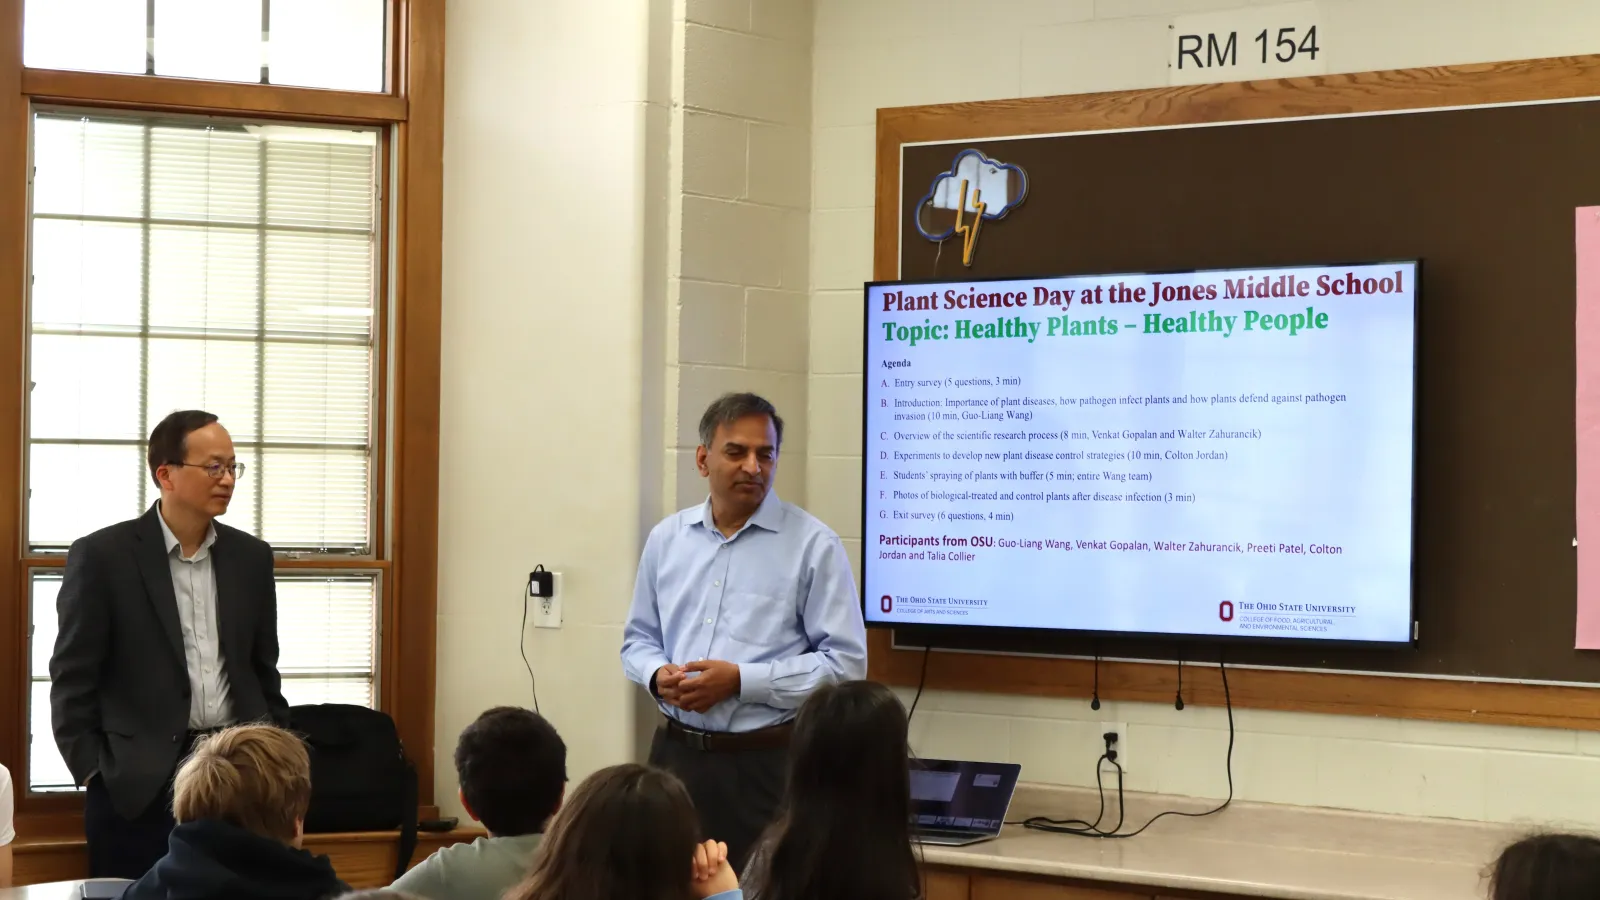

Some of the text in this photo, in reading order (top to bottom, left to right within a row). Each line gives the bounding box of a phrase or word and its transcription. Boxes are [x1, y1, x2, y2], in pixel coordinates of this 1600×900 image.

[1178, 25, 1319, 69] RM 154
[882, 270, 1403, 312] Plant Science Day at the Jones Middle School
[882, 319, 948, 346] Topic:
[955, 317, 1041, 343] Healthy
[1047, 314, 1118, 337] Plants
[1143, 310, 1237, 337] Healthy
[1244, 307, 1328, 336] People
[881, 359, 911, 369] Agenda
[881, 376, 1021, 389] A. Entry survey (5 questions, 3 min)
[880, 393, 1346, 408] B. Introduction: Importance of plant diseases, how pathogen infect plants and how plants defend against pathogen
[894, 411, 1033, 422] invasion (10 min, Guo-Liang Wang)
[880, 429, 1262, 442] C. Overview of the scientific research process (8 min, Venkat Gopalan and Walter Zahurancik)
[894, 451, 941, 462] Experiments
[942, 451, 950, 460] to
[952, 451, 982, 462] develop
[985, 452, 1000, 460] new
[1003, 451, 1023, 462] plant
[1025, 451, 1053, 459] disease
[1055, 451, 1084, 459] control
[1087, 451, 1125, 462] strategies
[1127, 451, 1140, 460] (10
[1143, 451, 1162, 461] min,
[1165, 451, 1194, 460] Colton
[1196, 450, 1227, 460] Jordan)
[930, 472, 962, 482] spraying
[964, 471, 972, 480] of
[975, 472, 997, 482] plants
[1000, 471, 1017, 480] with
[1019, 471, 1043, 480] buffer
[1046, 472, 1054, 481] (5
[1056, 472, 1075, 482] min;
[1077, 472, 1100, 481] entire
[1102, 472, 1126, 483] Wang
[1128, 472, 1151, 482] team)
[880, 491, 1195, 503] F. Photos of biological-treated and control plants after disease infection (3 min)
[879, 511, 1014, 522] G. Exit survey (6 questions, 4 min)
[879, 535, 1342, 555] Participants from OSU: Guo-Liang Wang, Venkat Gopalan, Walter Zahurancik, Preeti Patel, Colton
[879, 551, 975, 561] Jordan and Talia Collier
